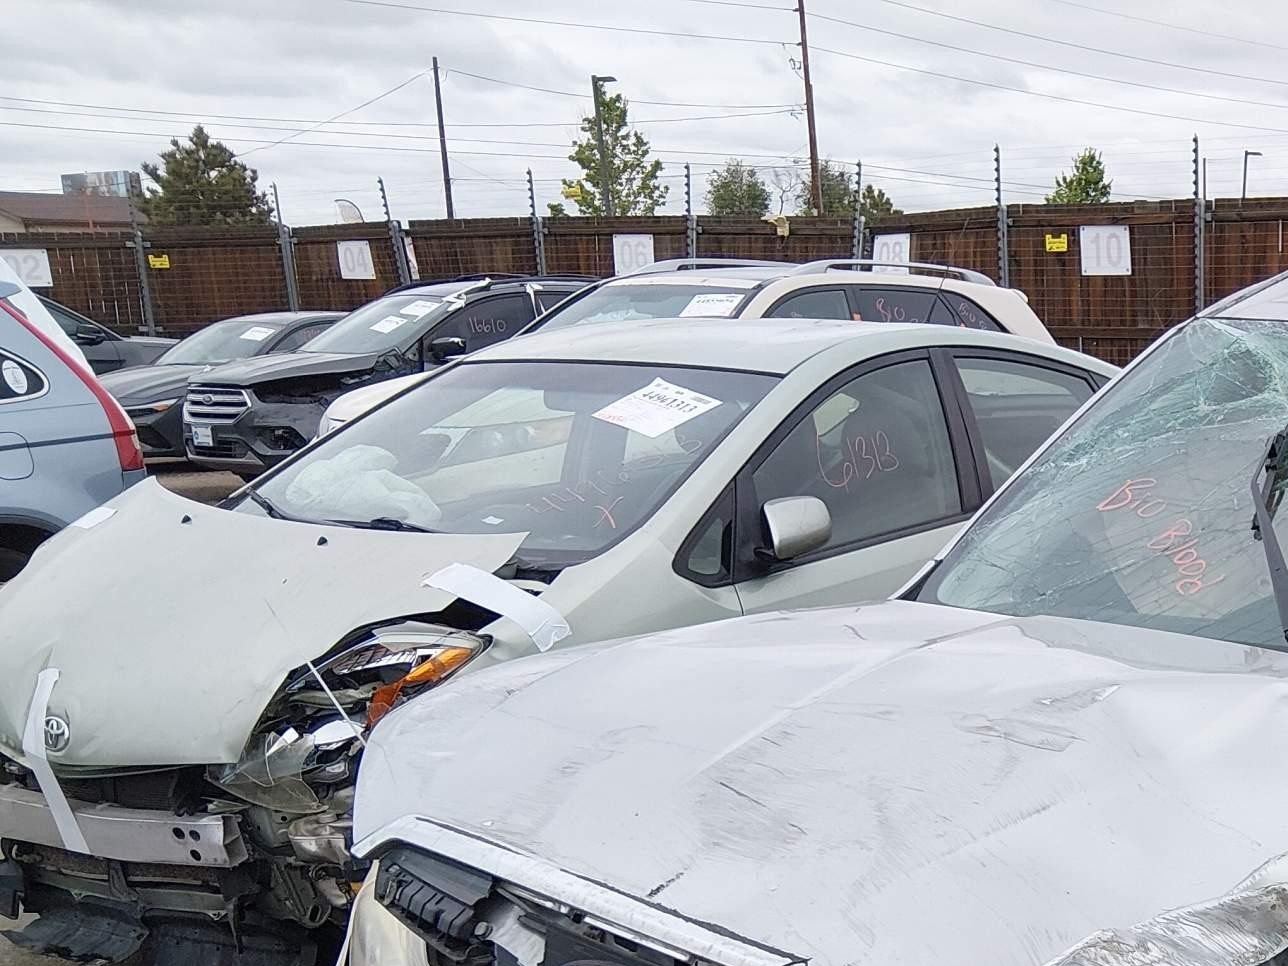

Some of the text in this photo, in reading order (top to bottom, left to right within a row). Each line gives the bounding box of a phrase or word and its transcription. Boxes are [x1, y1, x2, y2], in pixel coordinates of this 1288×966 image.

[343, 246, 368, 273] 04
[621, 240, 647, 269] 06
[1089, 232, 1122, 267] 10
[469, 316, 506, 333] 16610
[1096, 478, 1225, 595] Bio Blood
